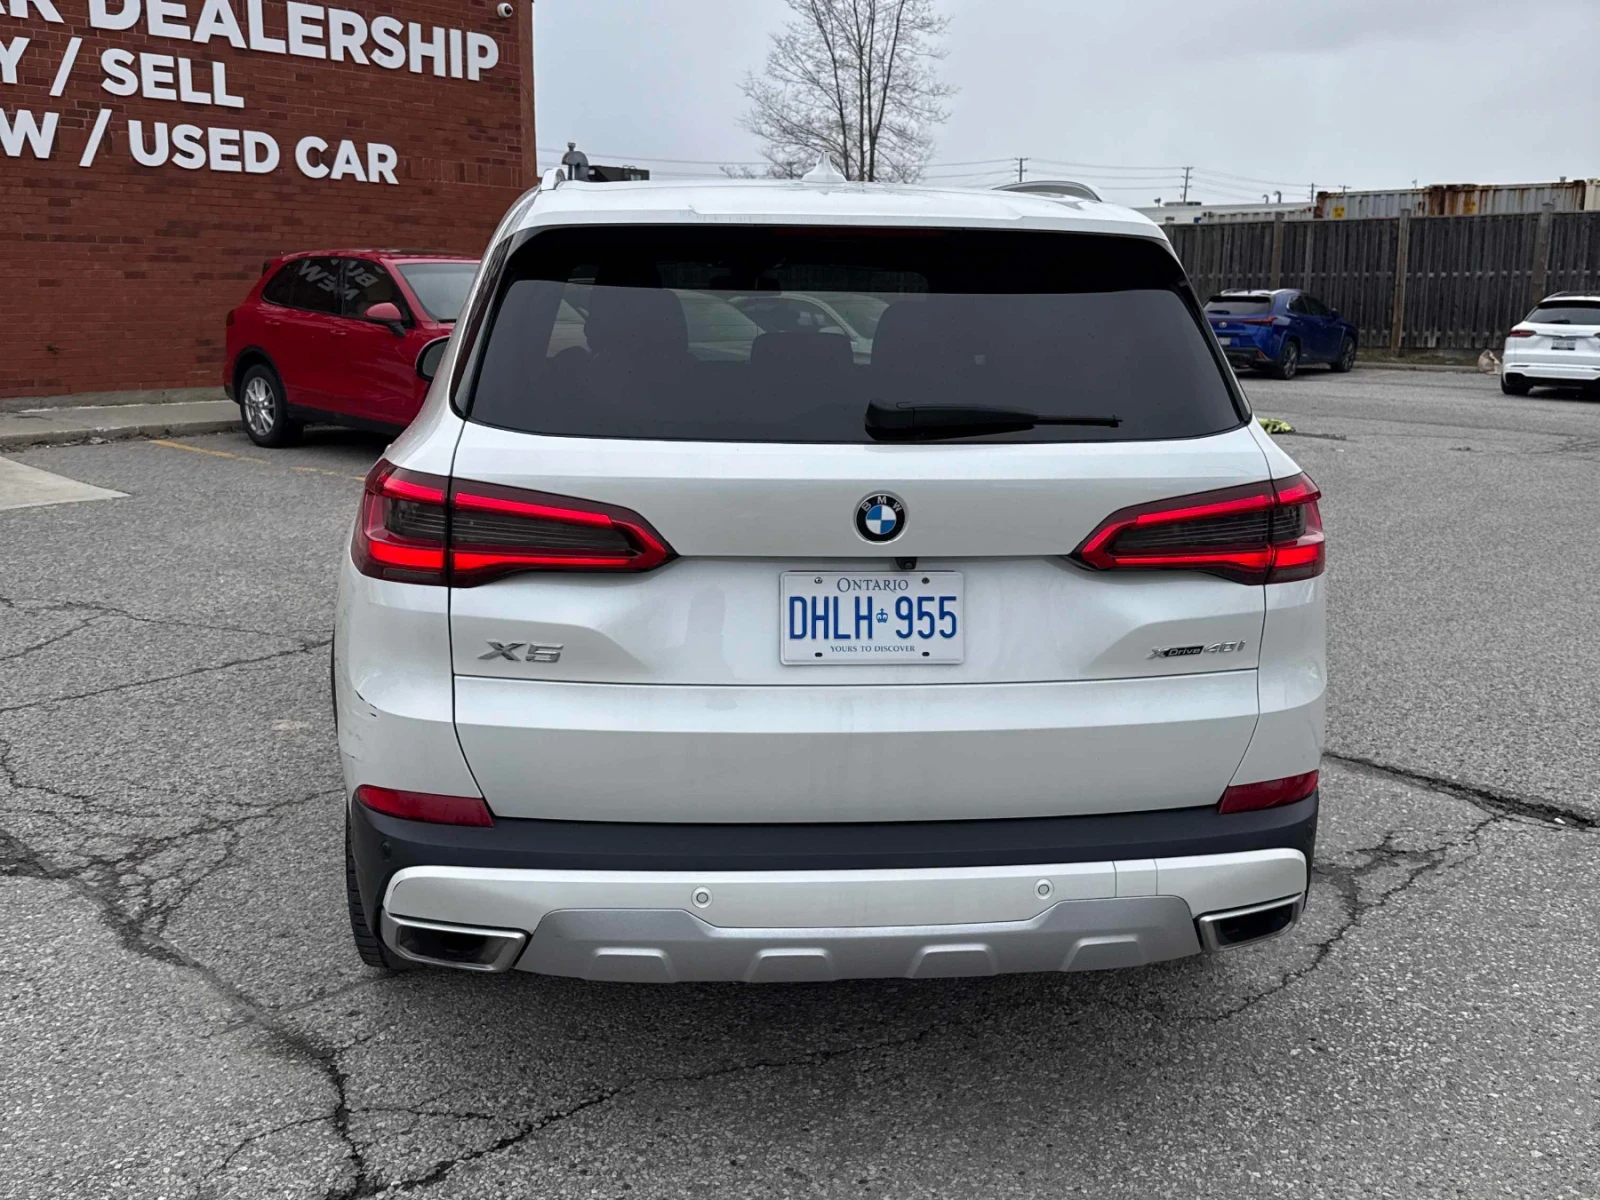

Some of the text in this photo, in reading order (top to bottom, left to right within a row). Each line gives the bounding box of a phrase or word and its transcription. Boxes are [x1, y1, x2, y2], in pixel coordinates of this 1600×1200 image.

[50, 36, 83, 97] /
[101, 48, 245, 109] SELL
[79, 108, 112, 167] /
[128, 119, 280, 174] USED
[295, 136, 399, 185] CAR
[861, 496, 902, 512] BMW
[789, 596, 957, 640] DHLH 955
[477, 640, 564, 663] X5
[830, 645, 916, 653] YOURS TO DISCOVER
